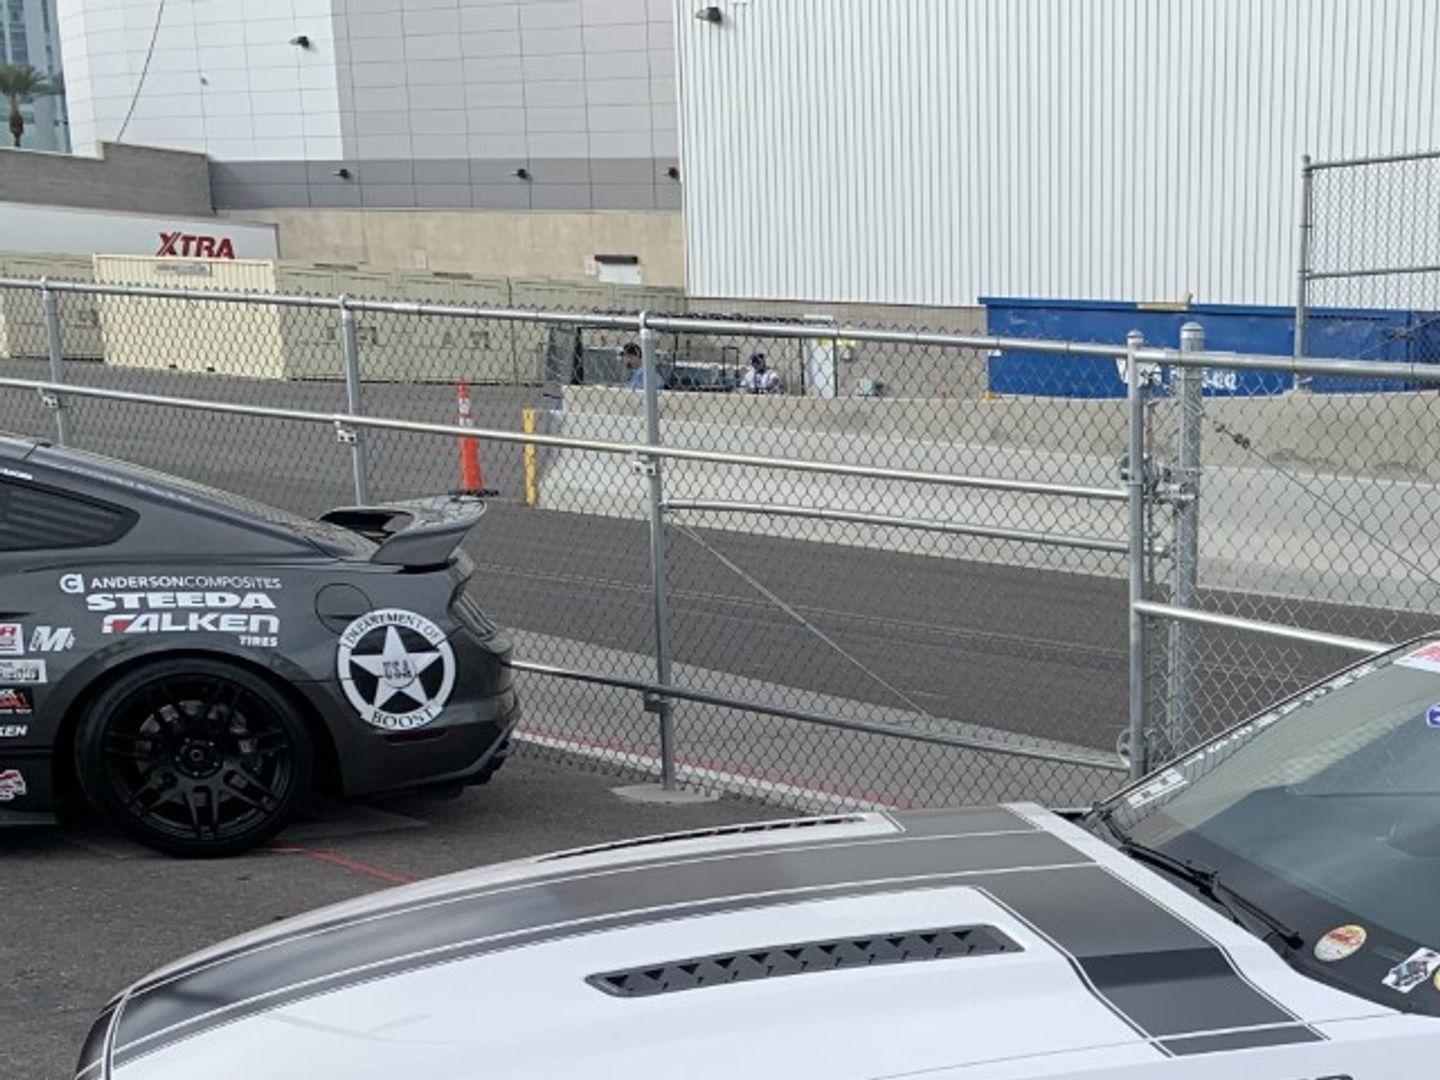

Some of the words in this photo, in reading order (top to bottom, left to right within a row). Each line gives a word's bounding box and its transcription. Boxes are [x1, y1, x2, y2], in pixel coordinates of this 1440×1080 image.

[157, 232, 235, 259] XTRA
[90, 576, 282, 589] ANDERSONCOMPOSITES
[86, 592, 276, 611] STEEDA
[101, 612, 279, 634] FALKEN
[238, 635, 278, 647] TIRES
[371, 707, 435, 728] BOOST
